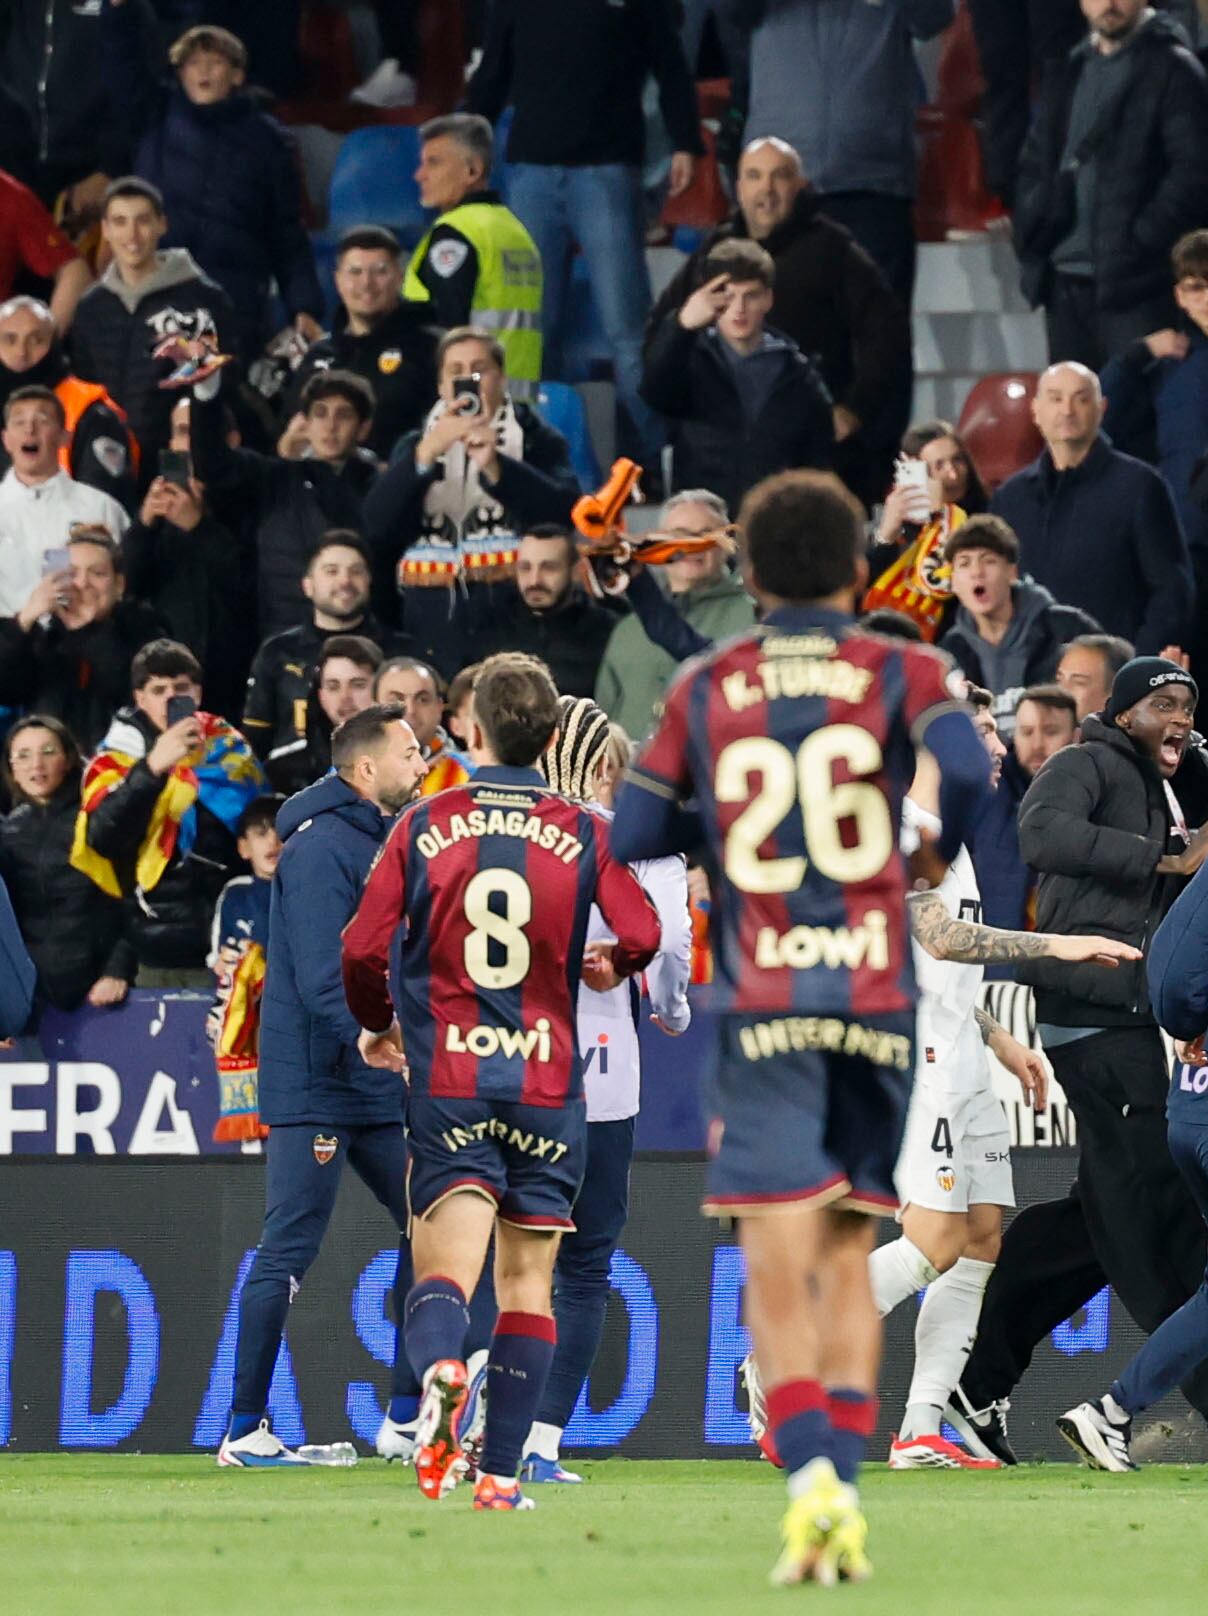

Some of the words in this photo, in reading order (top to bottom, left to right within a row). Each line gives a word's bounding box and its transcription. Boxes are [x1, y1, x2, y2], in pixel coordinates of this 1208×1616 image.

[416, 809, 583, 865] OLASAGASTI
[714, 723, 893, 893] 26
[463, 867, 532, 990] 8
[931, 1117, 954, 1159] 4
